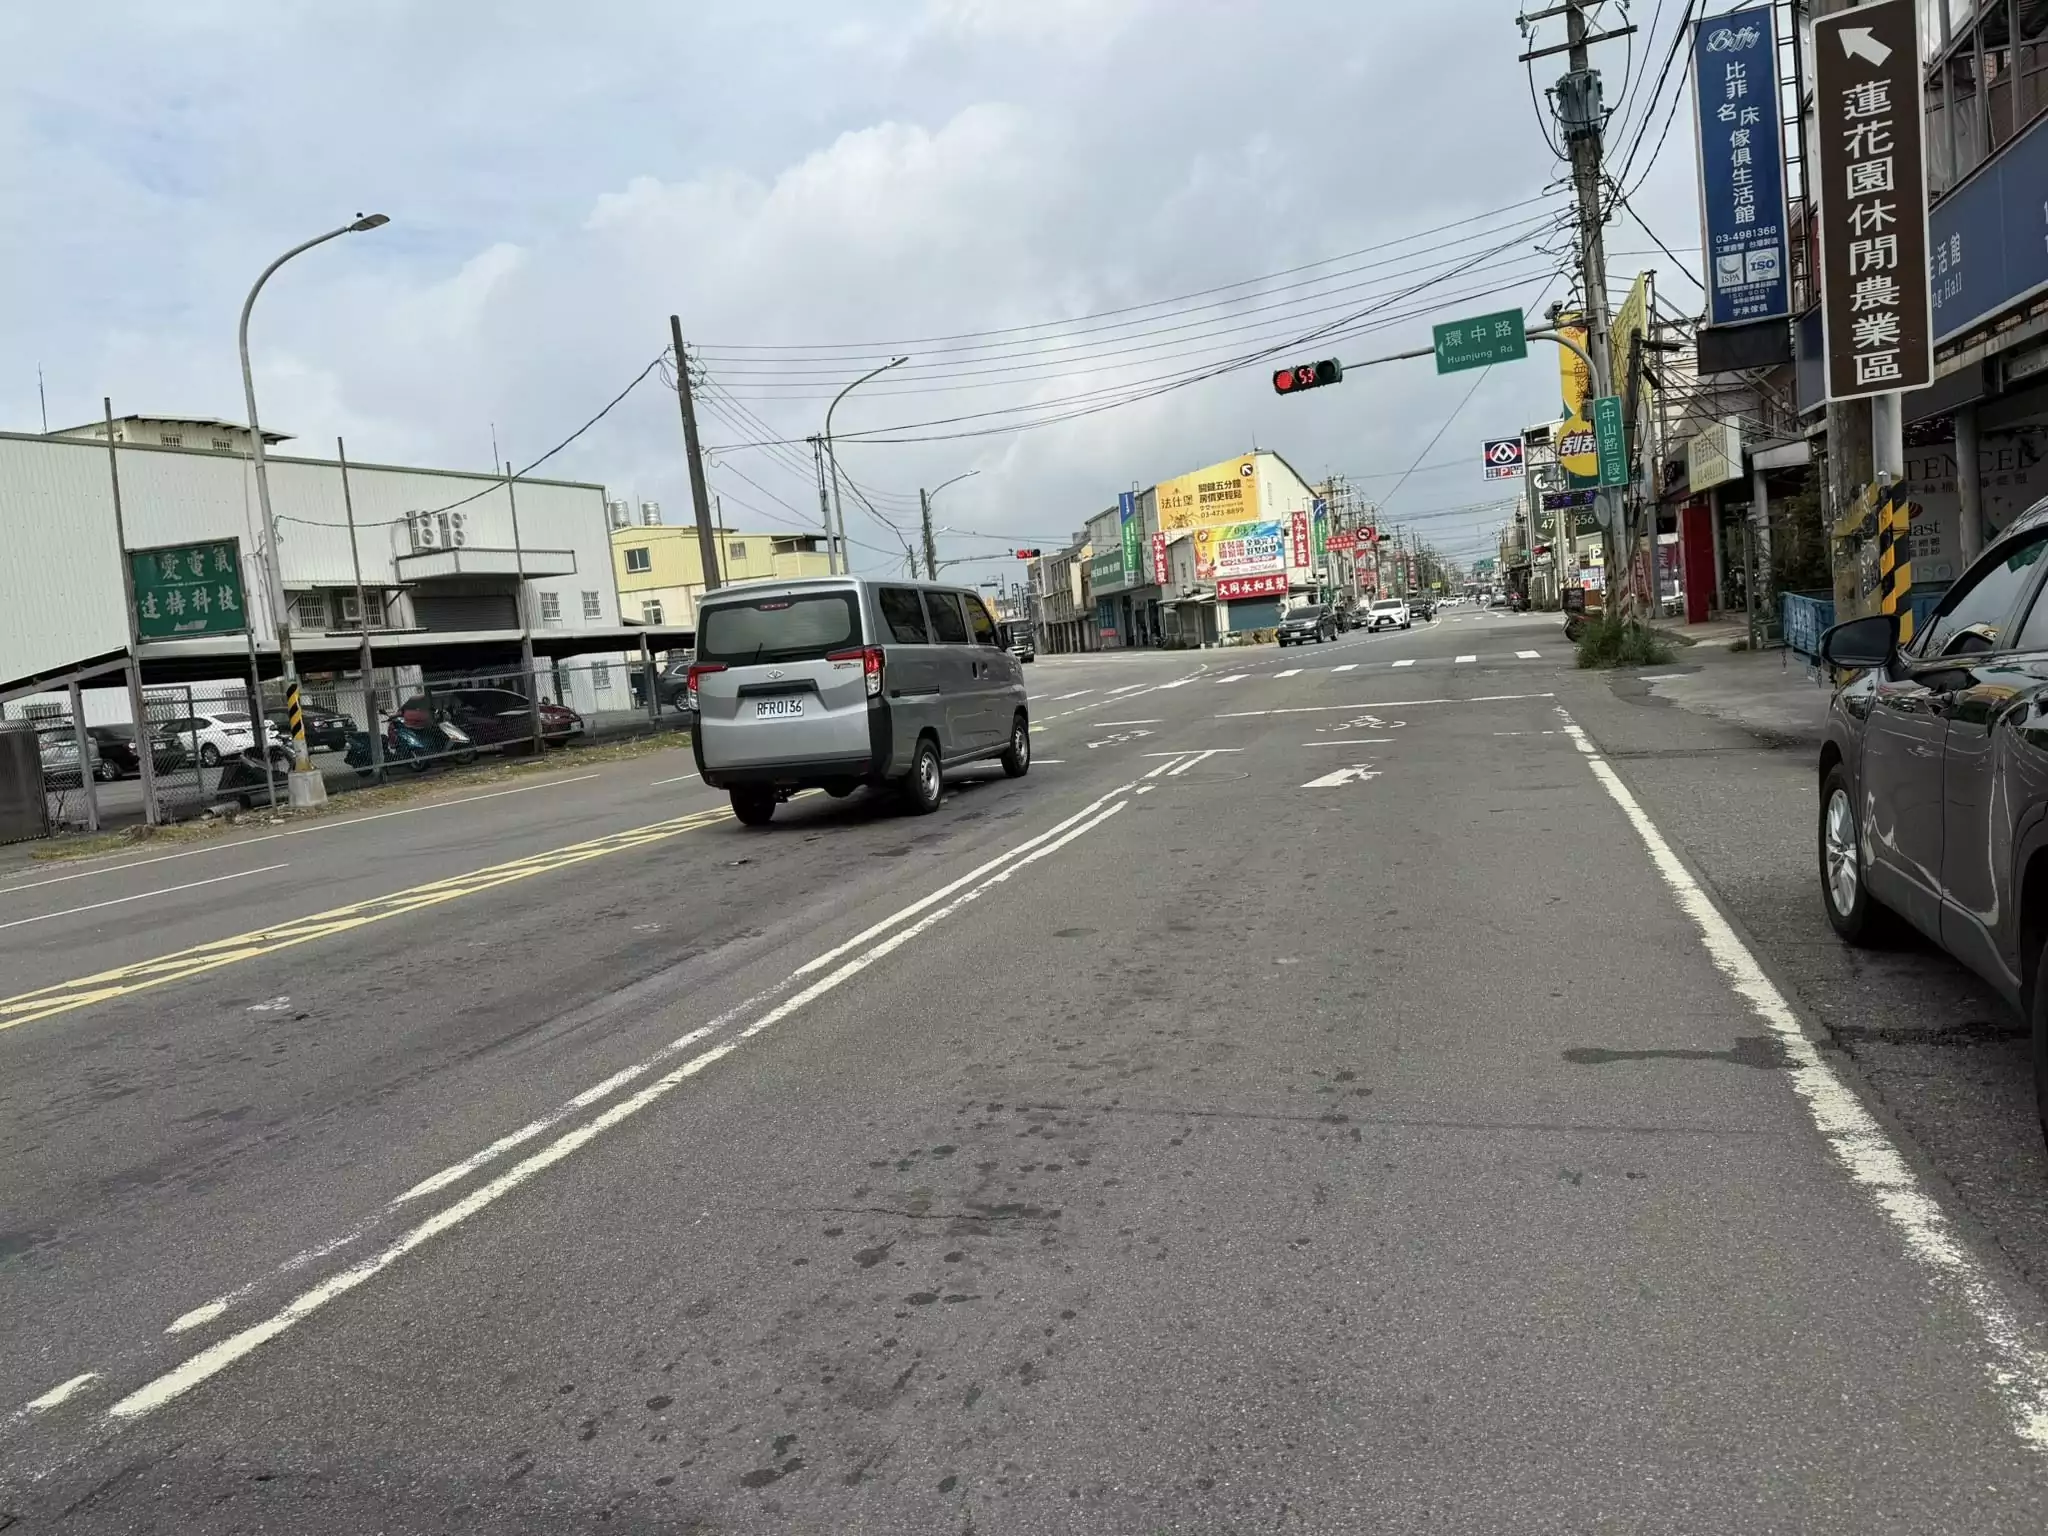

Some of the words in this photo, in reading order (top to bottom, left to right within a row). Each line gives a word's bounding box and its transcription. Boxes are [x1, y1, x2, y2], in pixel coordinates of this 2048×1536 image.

[1715, 225, 1777, 244] 03-4981368
[1842, 78, 1902, 386] 蓮花園休閒農業區
[1750, 259, 1776, 272] ISO
[1944, 271, 1962, 300] Hall
[1444, 320, 1513, 348] 環中路
[1447, 350, 1493, 365] Huanjung
[1500, 344, 1513, 354] Rd
[1298, 367, 1314, 385] 53
[141, 584, 240, 619] 達特科技
